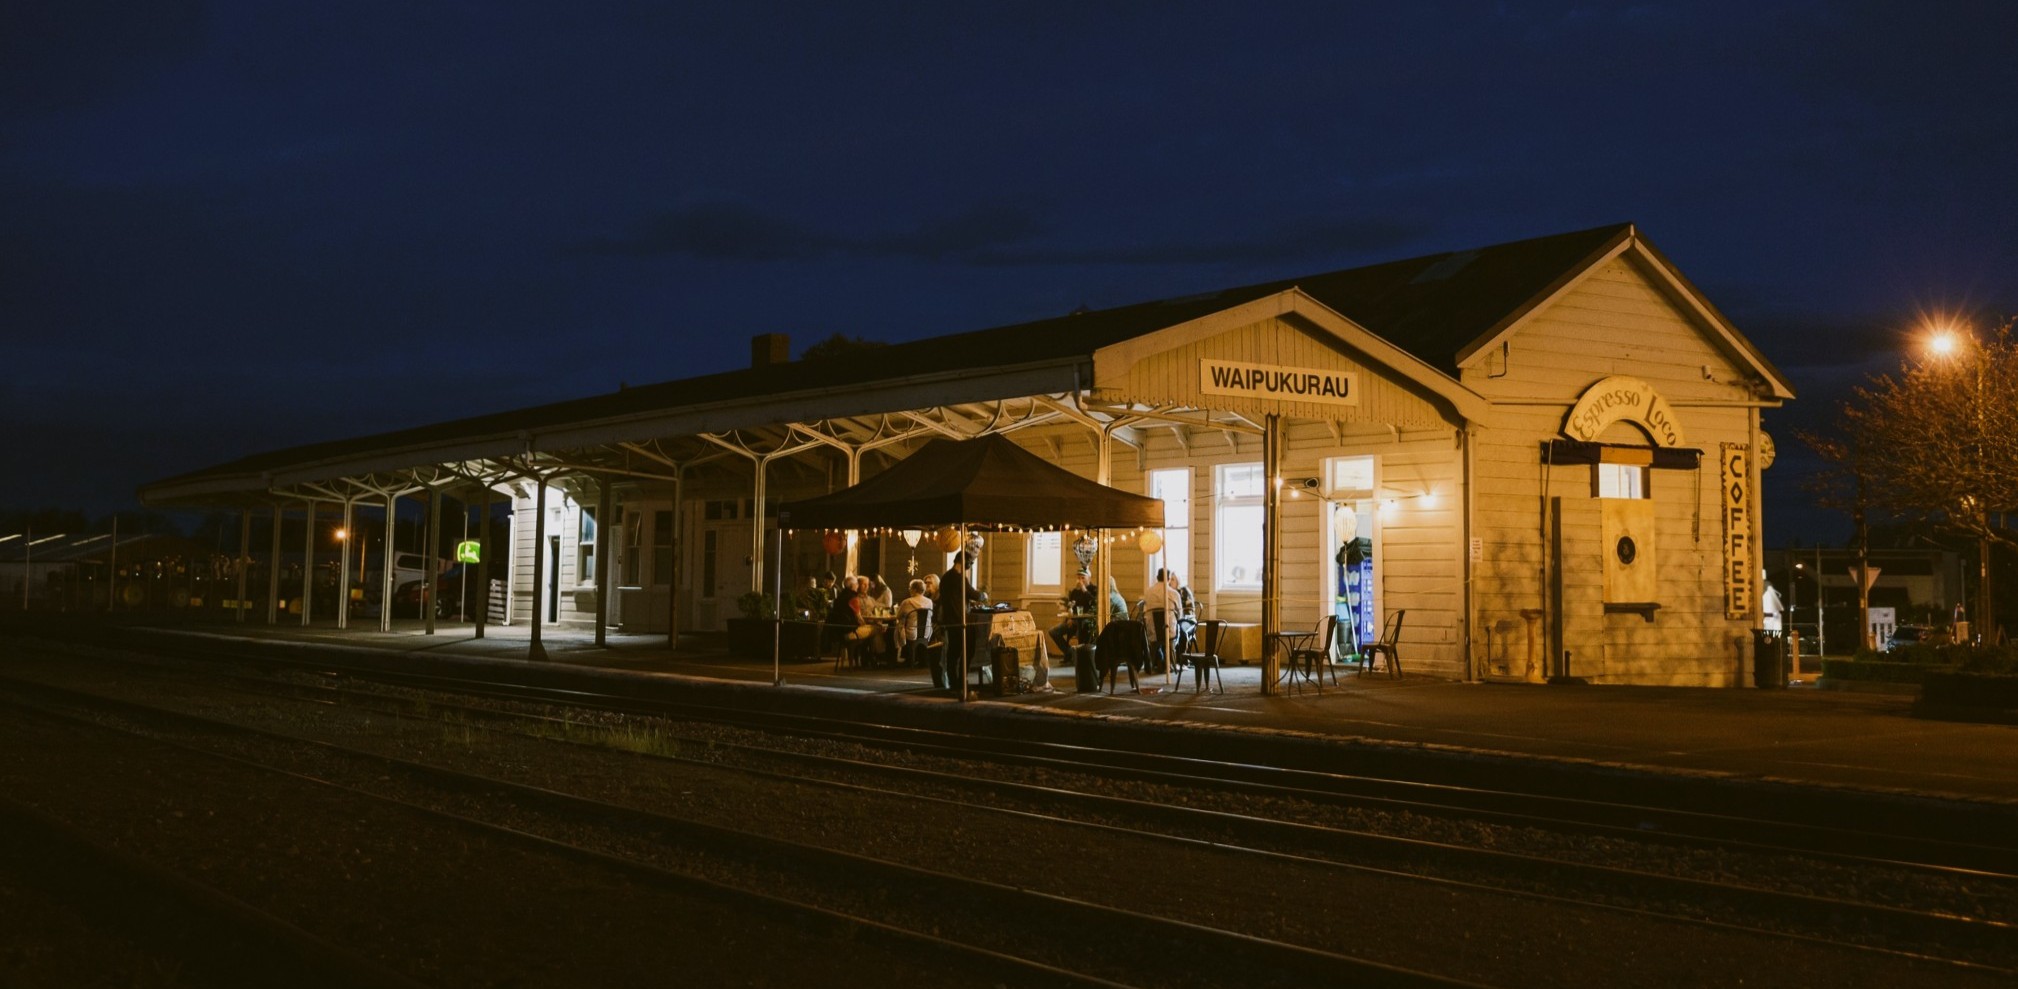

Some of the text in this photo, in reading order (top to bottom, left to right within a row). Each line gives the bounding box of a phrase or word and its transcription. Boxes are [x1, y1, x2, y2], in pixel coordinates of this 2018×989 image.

[1211, 366, 1349, 398] WAIPUKURAU
[1572, 390, 1640, 441] Espresso
[1729, 454, 1745, 610] COFFEE
